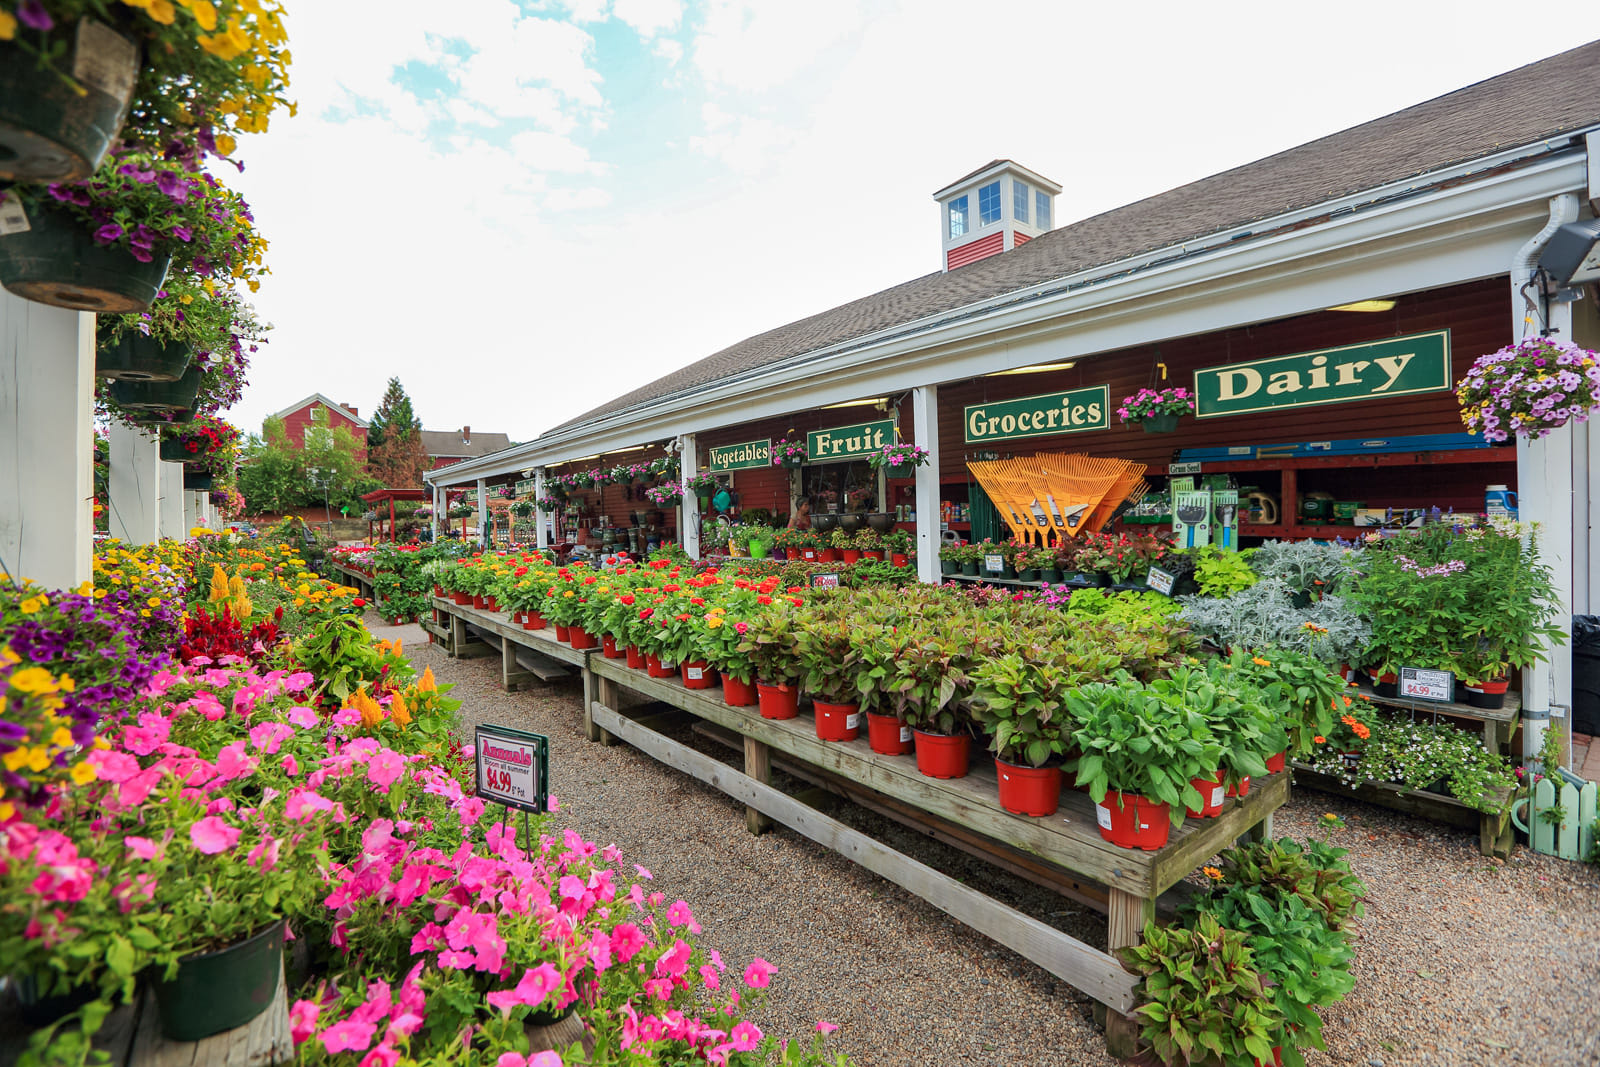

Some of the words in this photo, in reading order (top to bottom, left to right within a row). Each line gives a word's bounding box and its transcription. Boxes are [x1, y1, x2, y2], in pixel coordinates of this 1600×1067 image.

[1216, 353, 1416, 401] Dairy
[969, 396, 1102, 437] Groceries
[815, 427, 885, 456] Fruit
[711, 444, 768, 468] Vegetables
[1187, 463, 1200, 472] Seed
[1407, 684, 1430, 695] $4.99
[482, 740, 531, 766] Annuals
[486, 767, 511, 793] $4.99
[507, 765, 530, 775] summer
